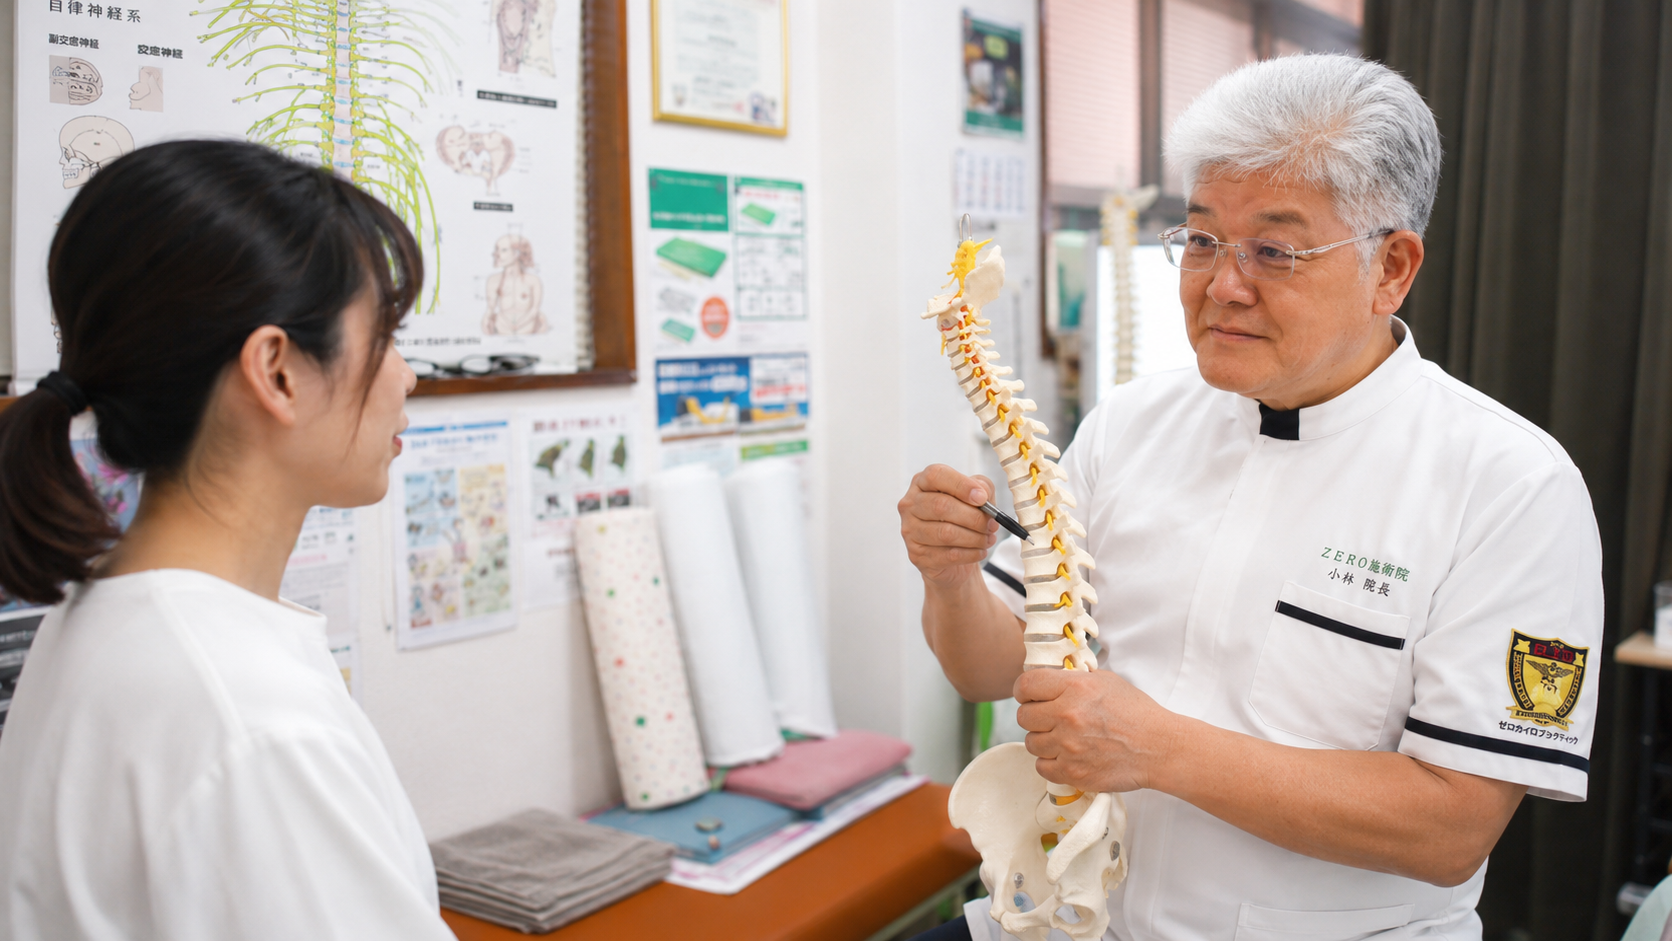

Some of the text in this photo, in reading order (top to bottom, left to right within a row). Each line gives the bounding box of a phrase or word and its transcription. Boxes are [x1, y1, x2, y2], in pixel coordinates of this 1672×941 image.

[49, 0, 141, 23] 自律神経系
[1321, 546, 1410, 582] ZERO施術院
[1328, 568, 1391, 597] 小林 院長
